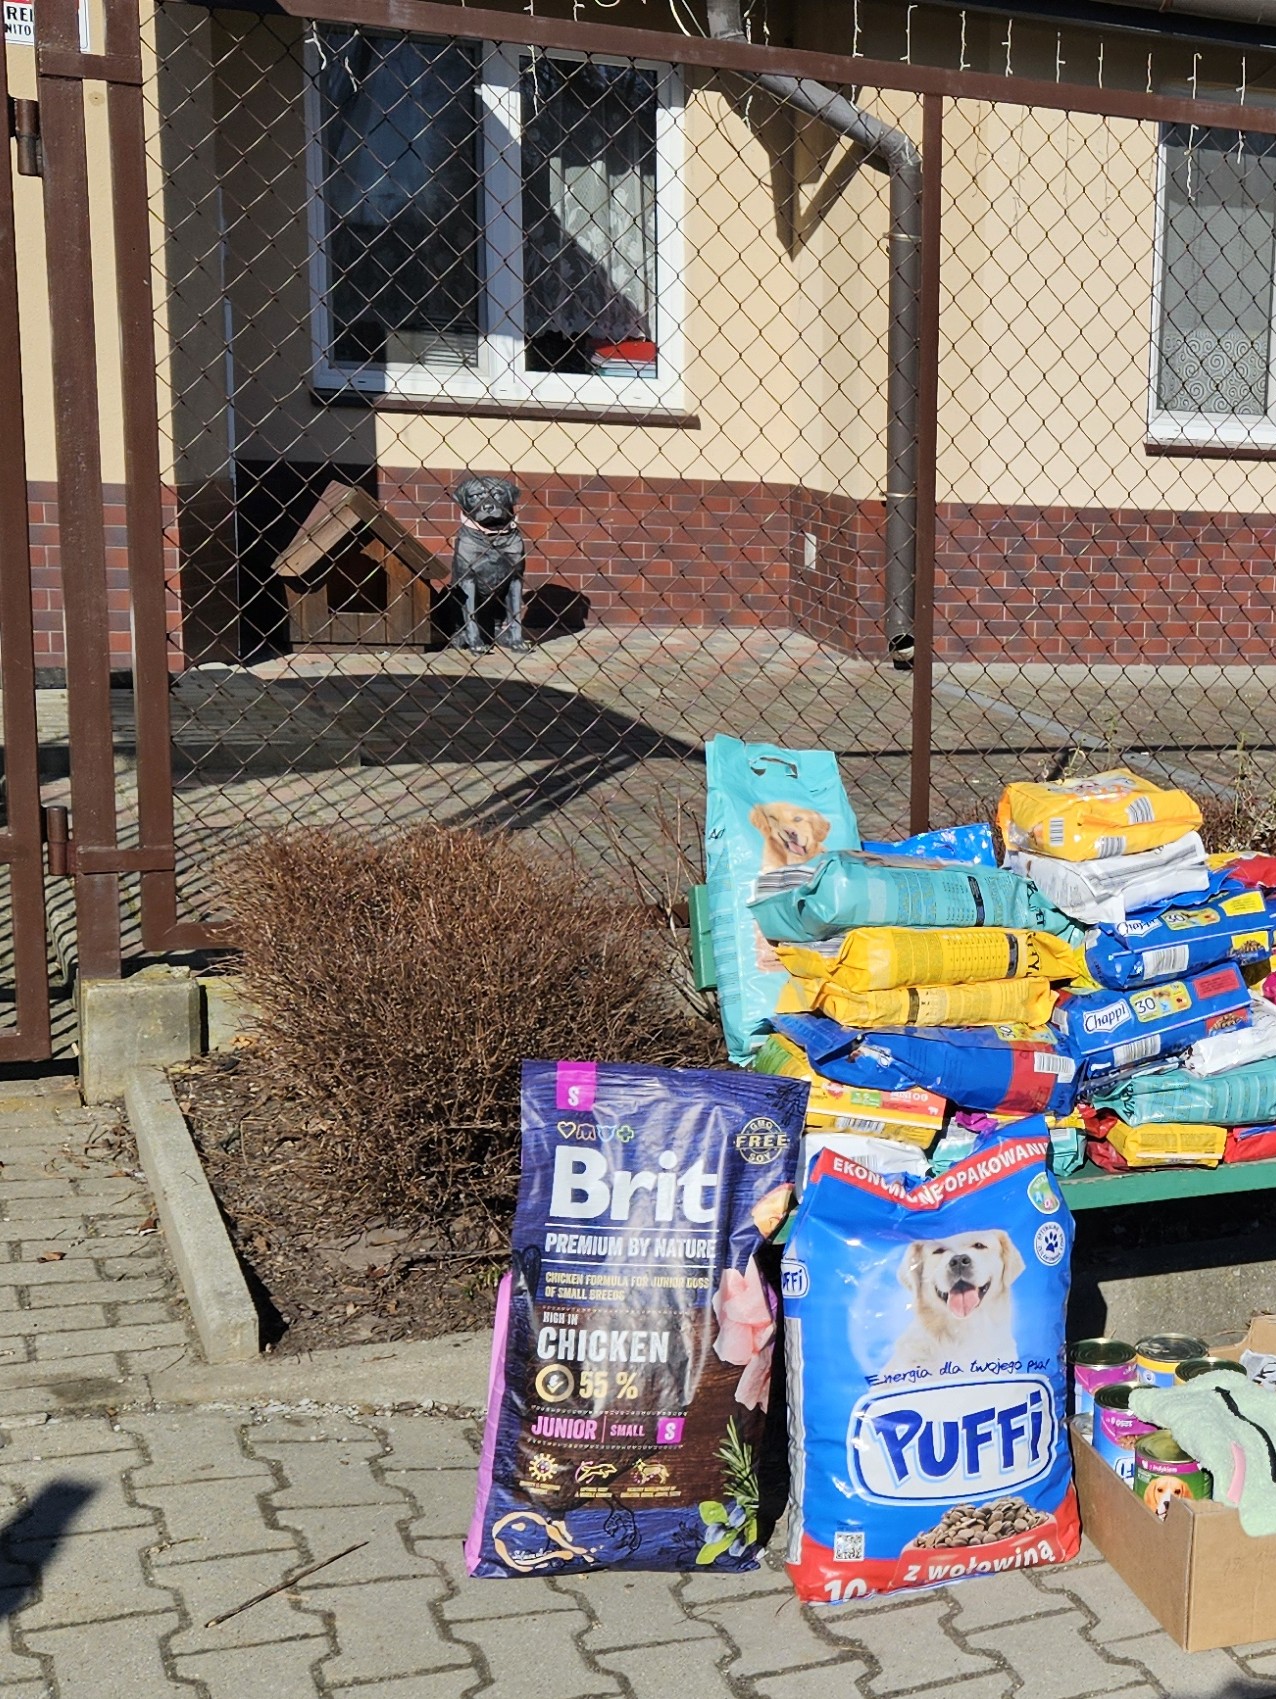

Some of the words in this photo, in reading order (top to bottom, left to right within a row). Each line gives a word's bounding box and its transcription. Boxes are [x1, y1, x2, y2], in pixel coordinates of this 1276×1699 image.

[1135, 997, 1156, 1014] 30
[568, 1086, 579, 1107] S
[736, 1135, 787, 1148] FREE
[749, 1152, 770, 1162] SOY
[550, 1145, 719, 1224] Brit
[544, 1232, 622, 1256] PREMIUM
[627, 1236, 650, 1258] BY
[653, 1237, 716, 1259] NATURE
[545, 1271, 584, 1285] CHICKEN
[585, 1274, 628, 1287] FORMULA
[631, 1275, 648, 1287] FOR
[651, 1276, 685, 1288] JUNIOR
[686, 1276, 710, 1289] DOGS
[545, 1286, 555, 1297] OF
[558, 1287, 587, 1300] SMALL
[589, 1289, 625, 1301] BREEDS
[543, 1311, 565, 1324] HIGH
[567, 1313, 578, 1326] IN
[537, 1327, 670, 1363] CHICKEN
[579, 1369, 608, 1399] 55
[616, 1371, 639, 1400] %
[864, 1365, 931, 1386] Energia
[940, 1361, 963, 1374] dla
[971, 1359, 1022, 1374] twojego
[531, 1416, 597, 1440] JUNIOR
[610, 1424, 645, 1437] SMALL
[664, 1422, 676, 1440] S
[903, 1564, 923, 1581] z
[927, 1539, 1056, 1581] wołowiną
[824, 1577, 868, 1601] 10
